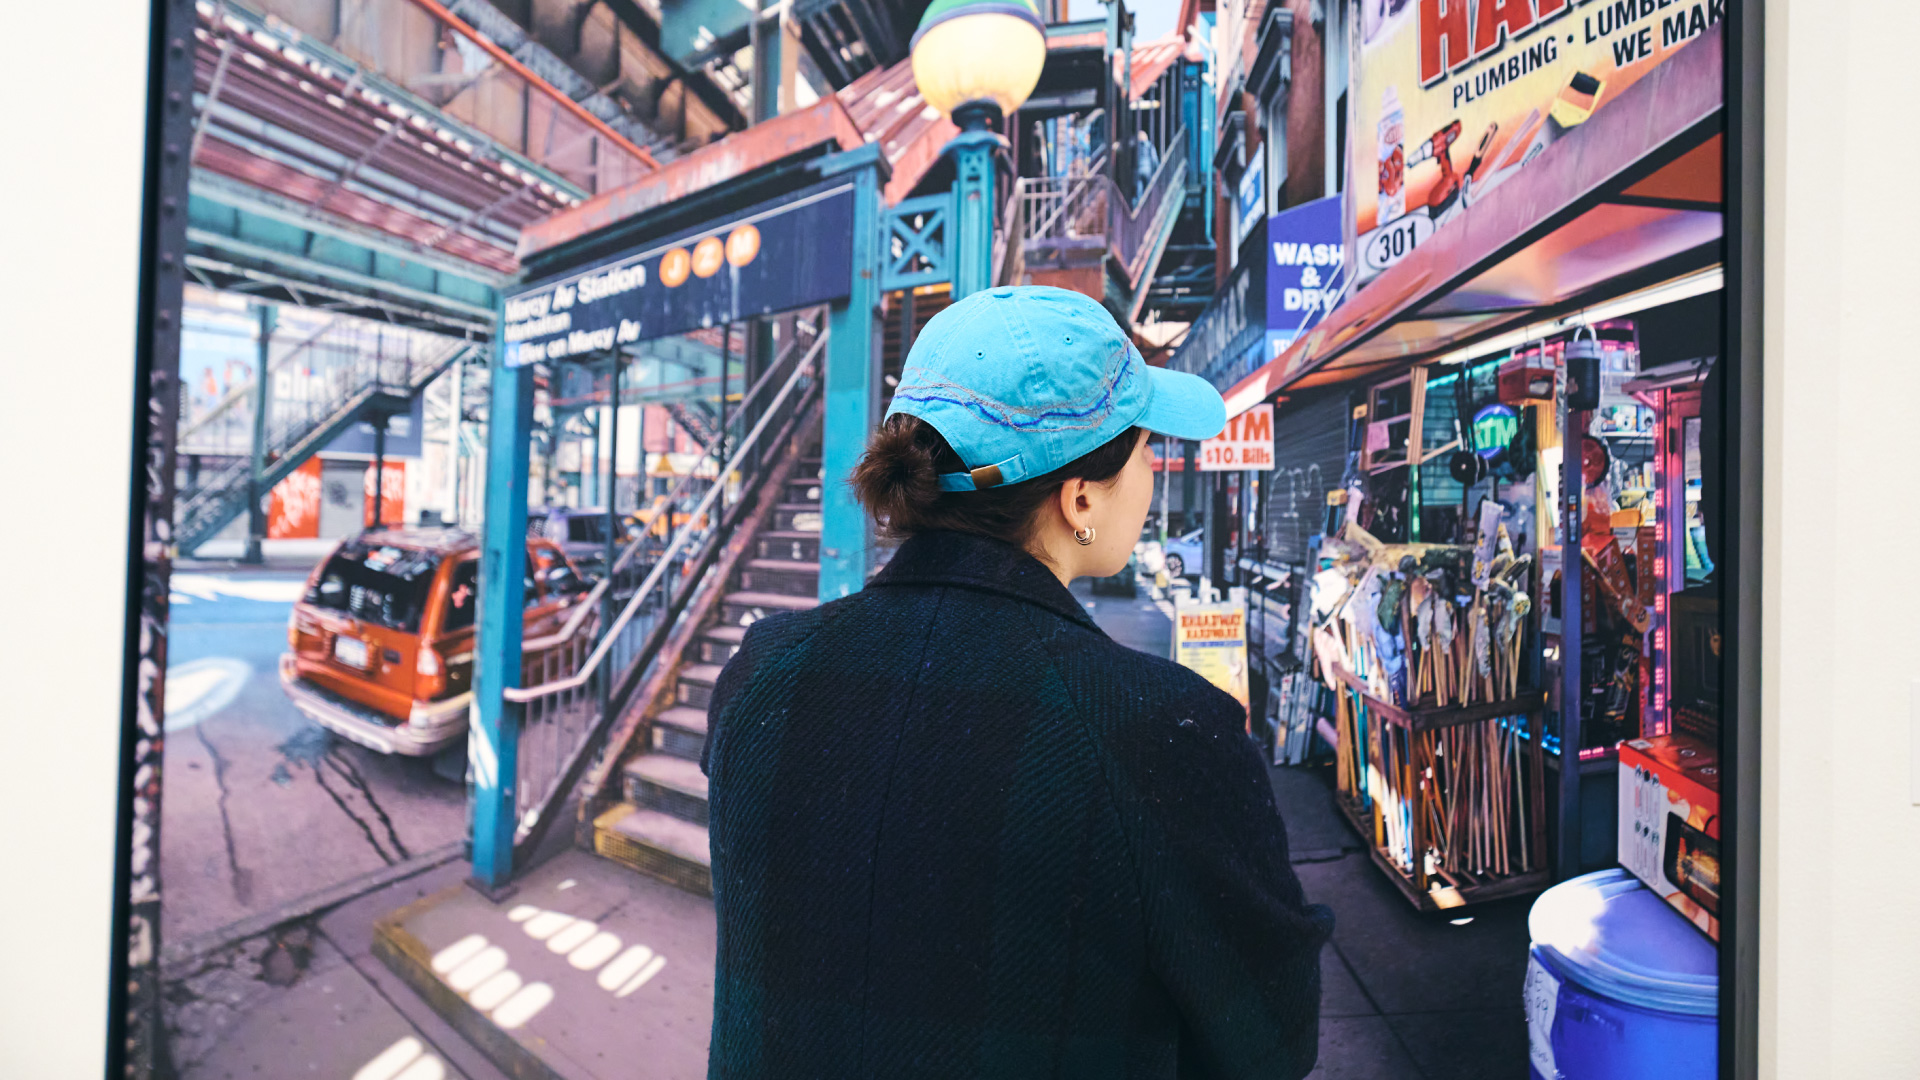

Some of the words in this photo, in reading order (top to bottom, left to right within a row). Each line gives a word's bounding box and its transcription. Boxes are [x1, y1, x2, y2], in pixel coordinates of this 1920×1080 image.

[1613, 27, 1651, 67] WE
[1453, 36, 1557, 108] PLUMBING
[1273, 242, 1344, 266] WASH
[1379, 220, 1416, 263] 301
[577, 264, 646, 304] Station
[1301, 266, 1321, 288] &
[1284, 288, 1339, 311] DRY
[1216, 412, 1270, 441] TM
[1242, 447, 1270, 464] Bills
